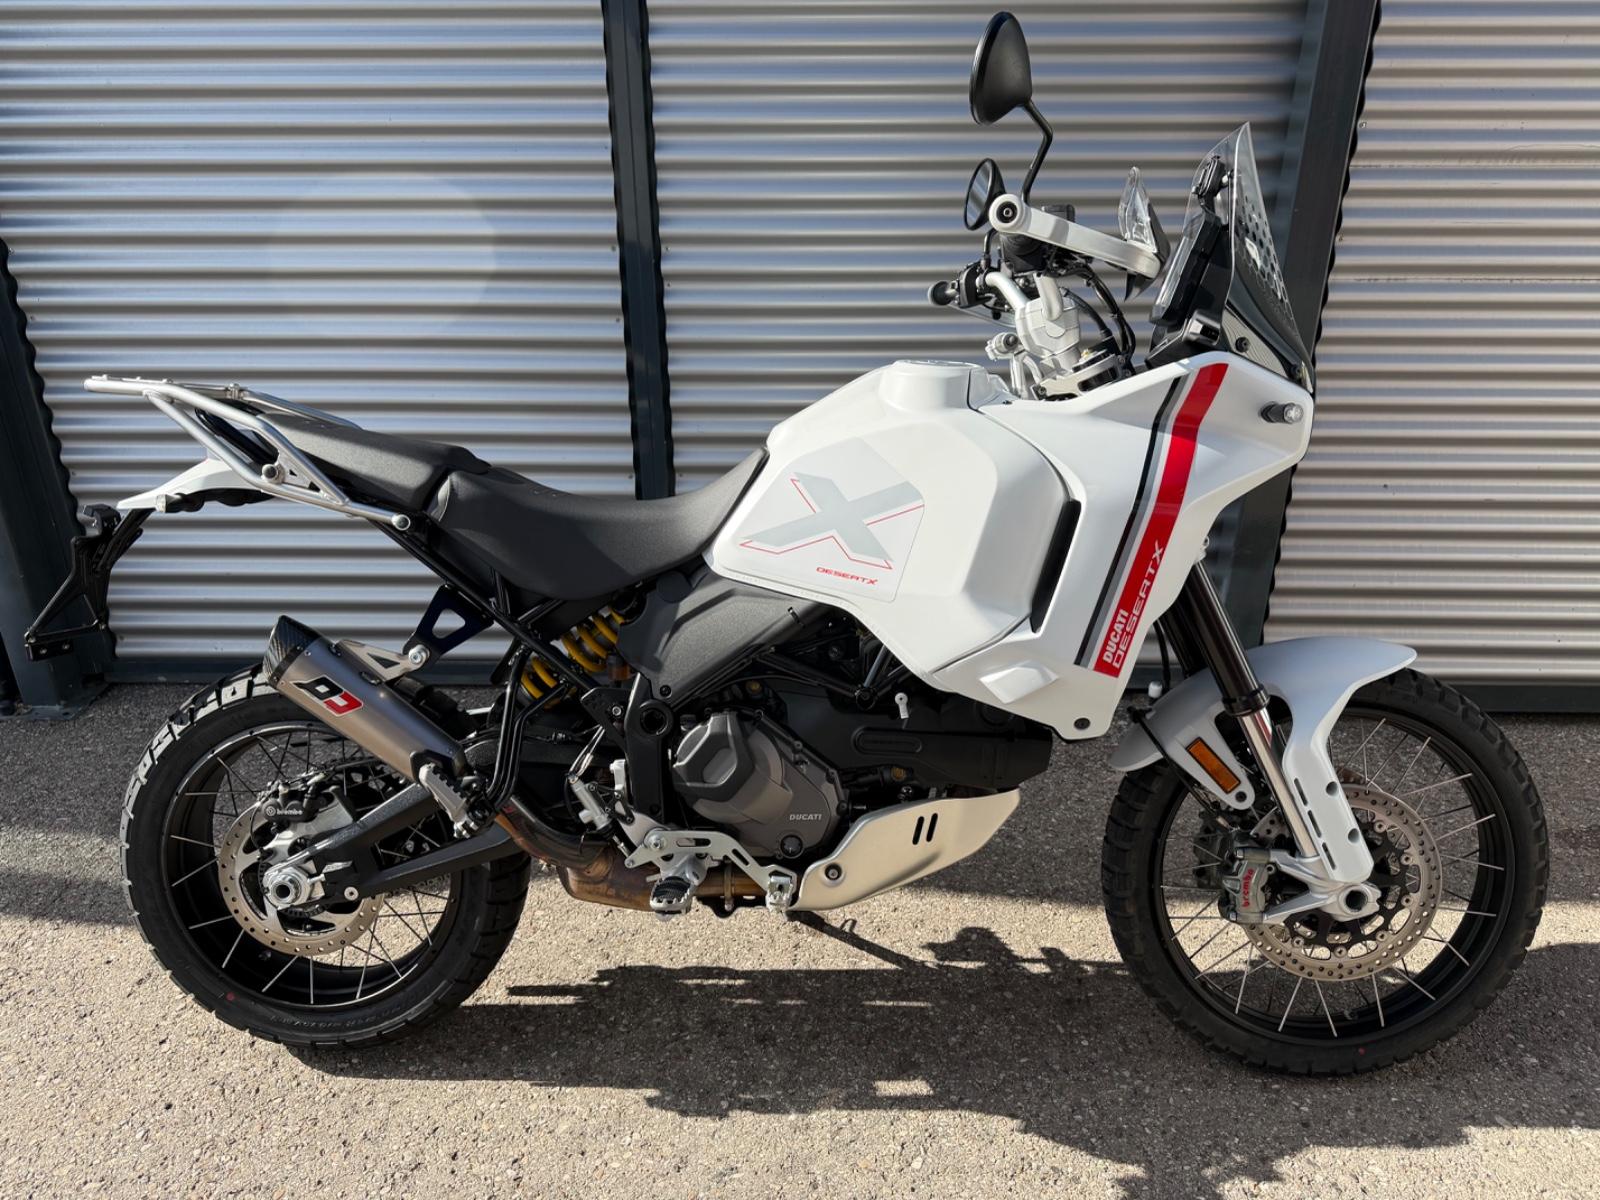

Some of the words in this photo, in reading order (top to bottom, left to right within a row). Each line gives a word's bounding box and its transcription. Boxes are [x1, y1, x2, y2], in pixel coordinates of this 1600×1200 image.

[816, 566, 878, 585] DESERTX
[1112, 539, 1164, 670] DESERTX
[1103, 609, 1128, 663] DUCATI
[789, 813, 822, 821] DUCATI
[1242, 868, 1255, 908] brembo
